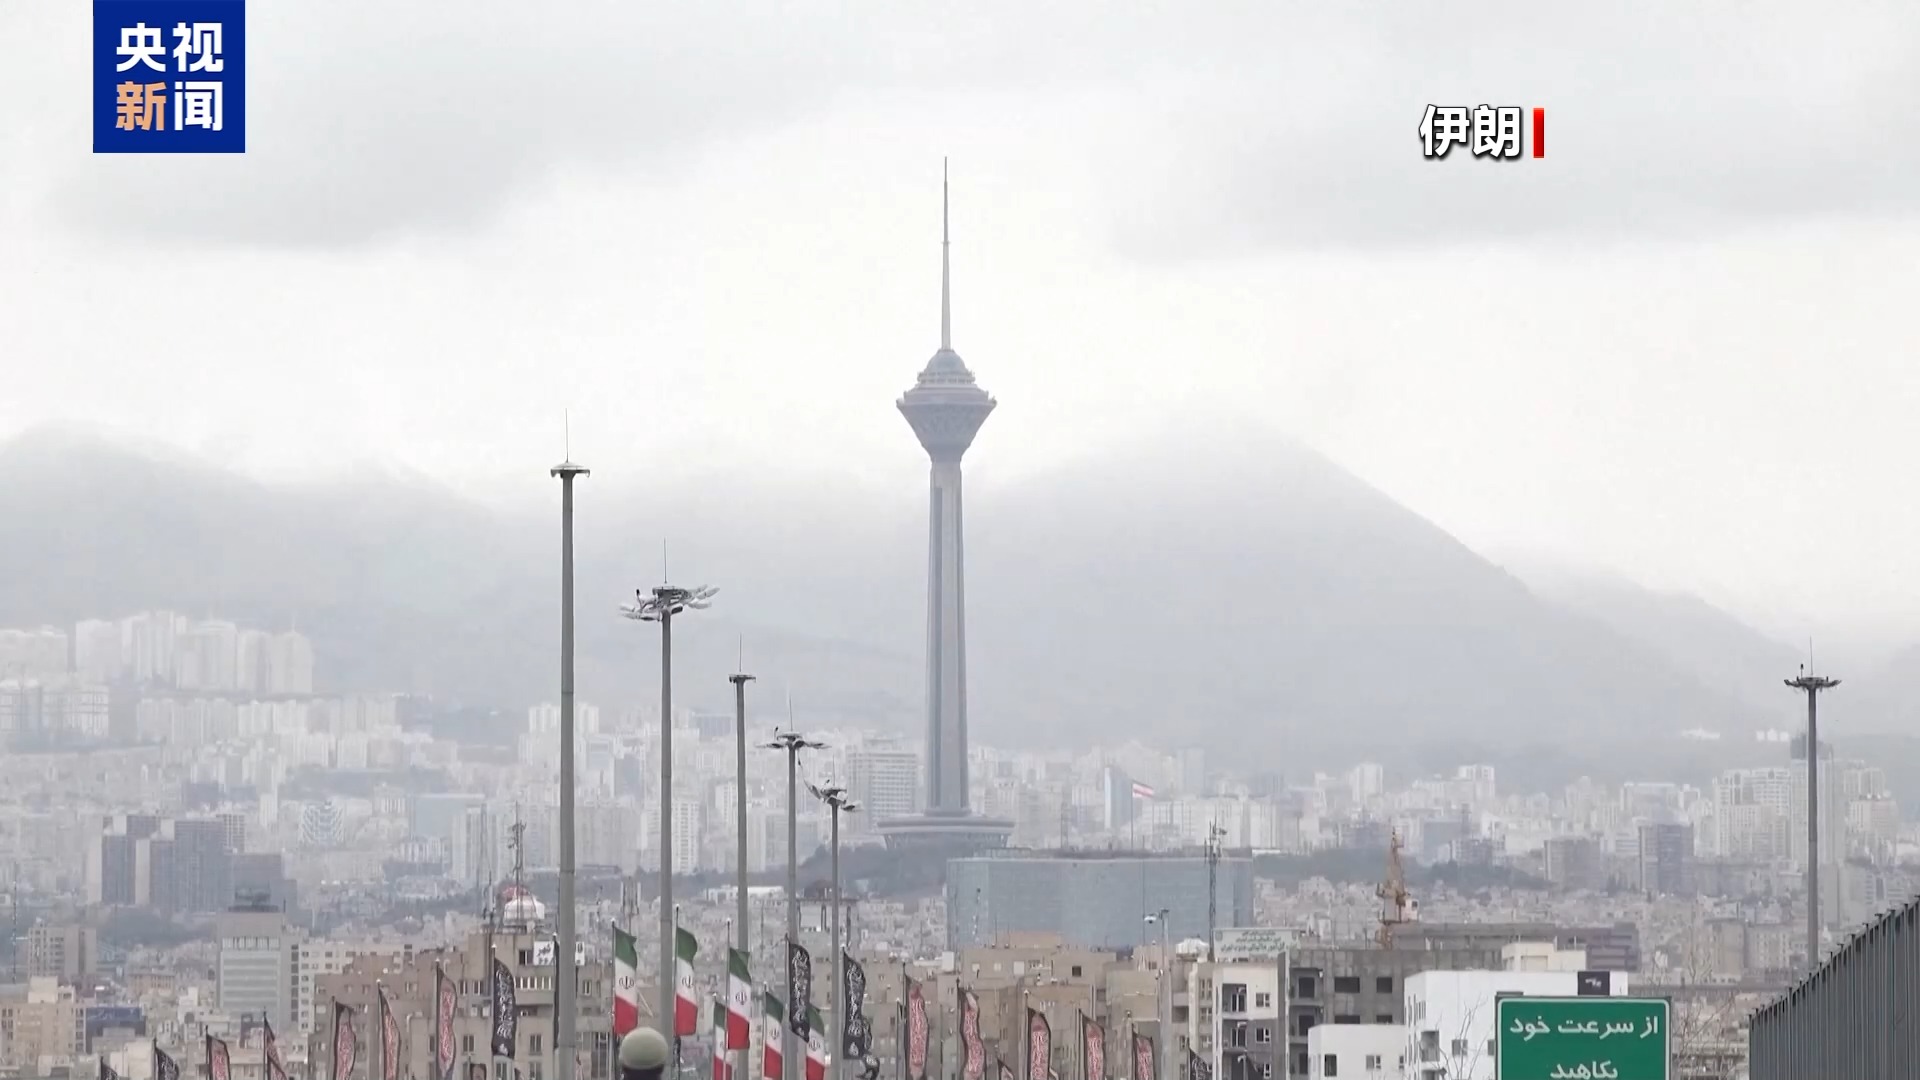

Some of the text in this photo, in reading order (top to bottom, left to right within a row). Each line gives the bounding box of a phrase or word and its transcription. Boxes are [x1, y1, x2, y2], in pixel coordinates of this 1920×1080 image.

[1509, 1015, 1659, 1042] از سرعت خود
